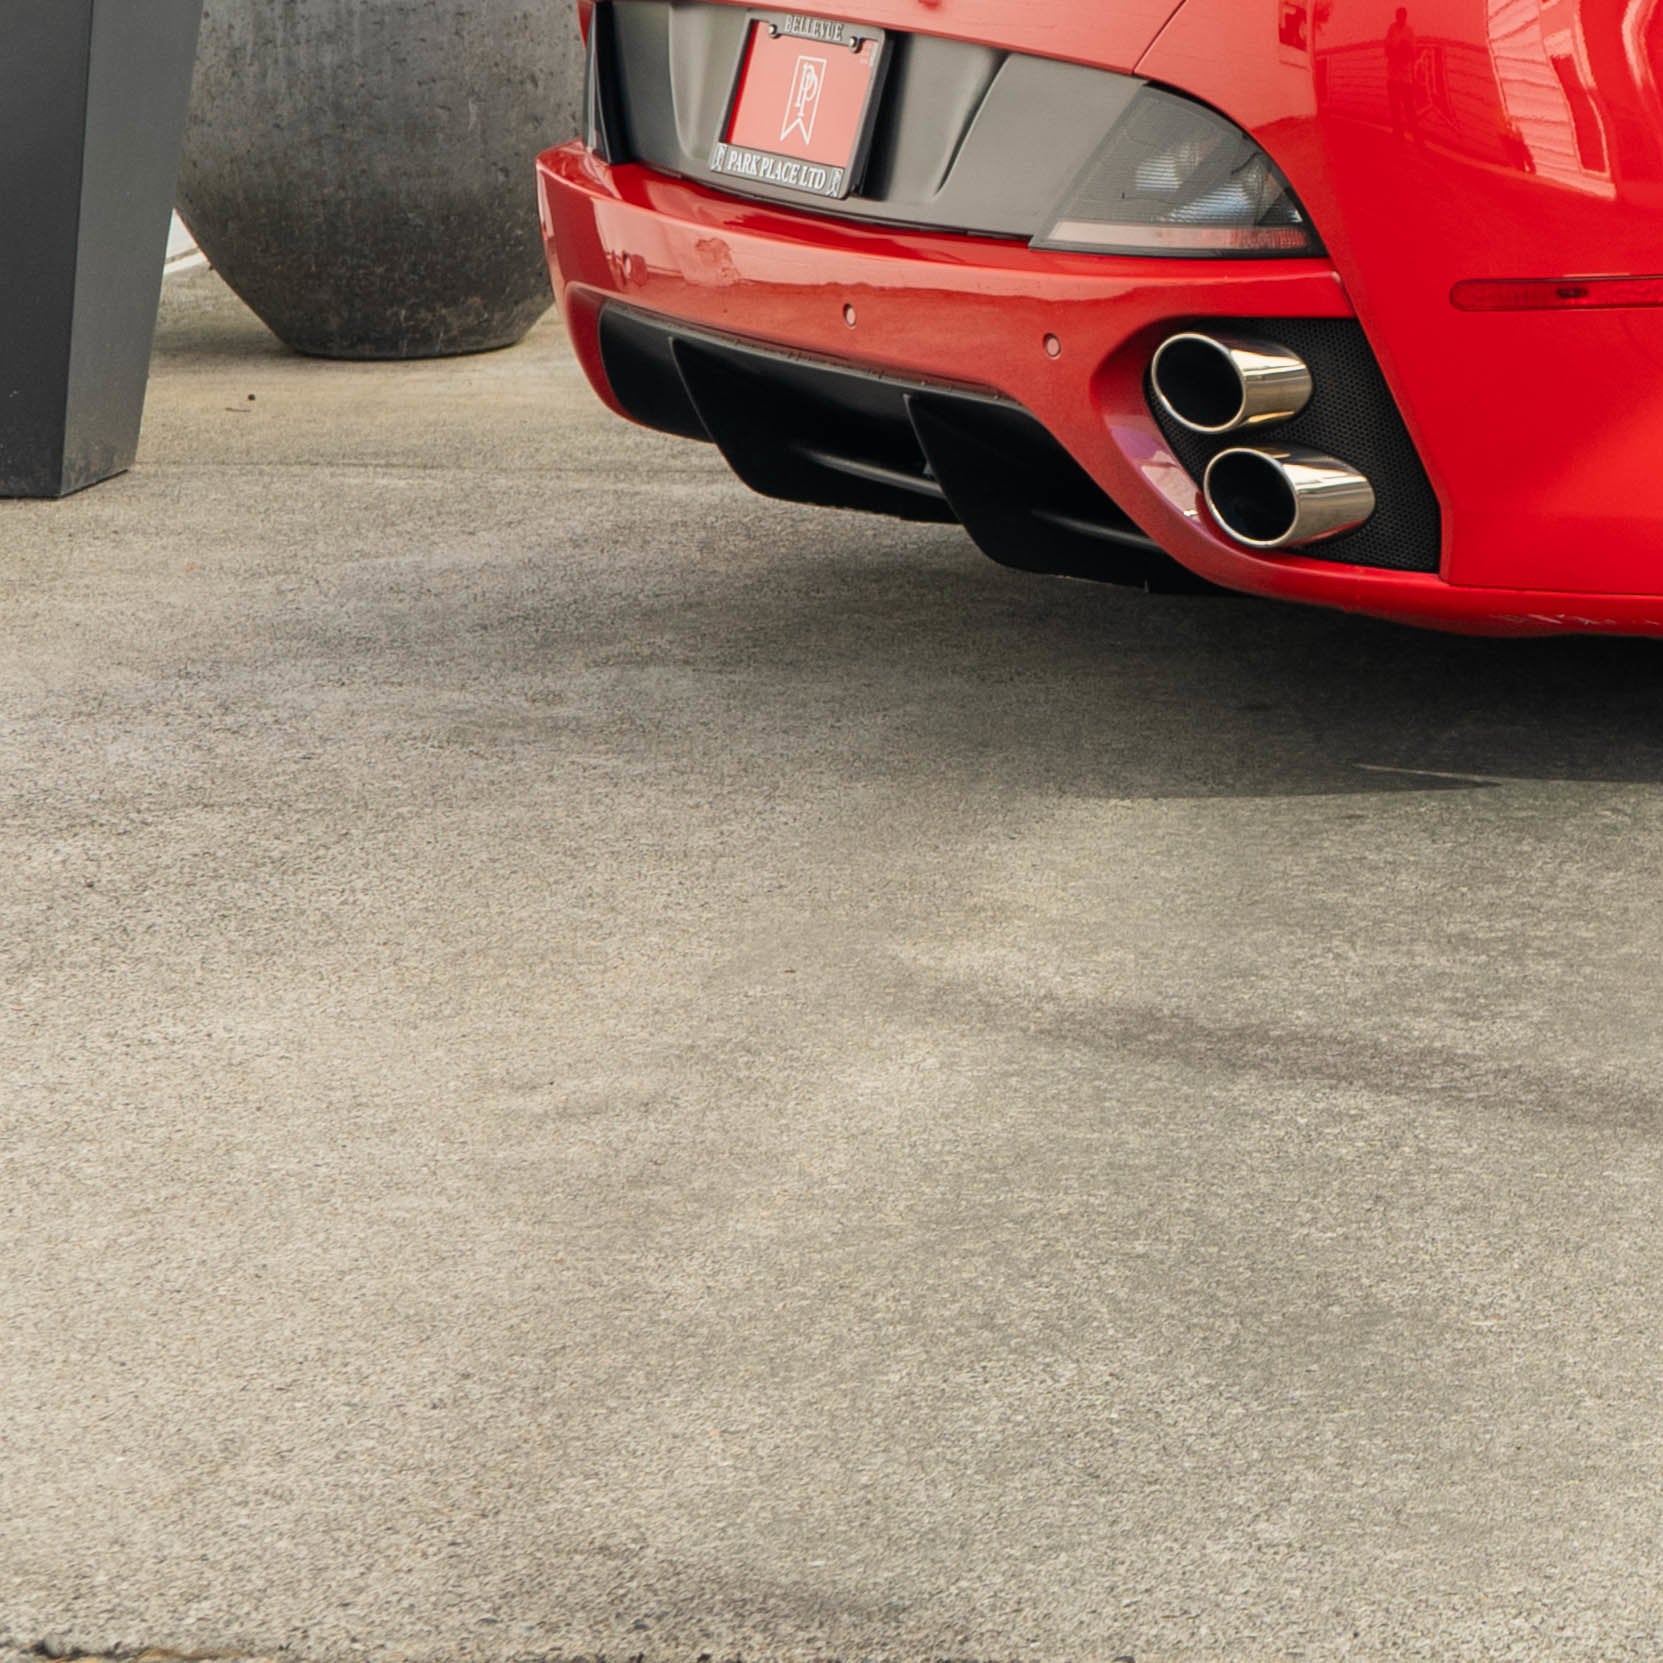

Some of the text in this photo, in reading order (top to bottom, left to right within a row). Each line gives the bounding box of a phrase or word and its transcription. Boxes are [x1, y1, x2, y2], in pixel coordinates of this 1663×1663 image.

[784, 15, 844, 41] BELLEVUE
[727, 150, 761, 177] PARK
[759, 157, 800, 185] PLACE
[800, 165, 827, 189] LTD
